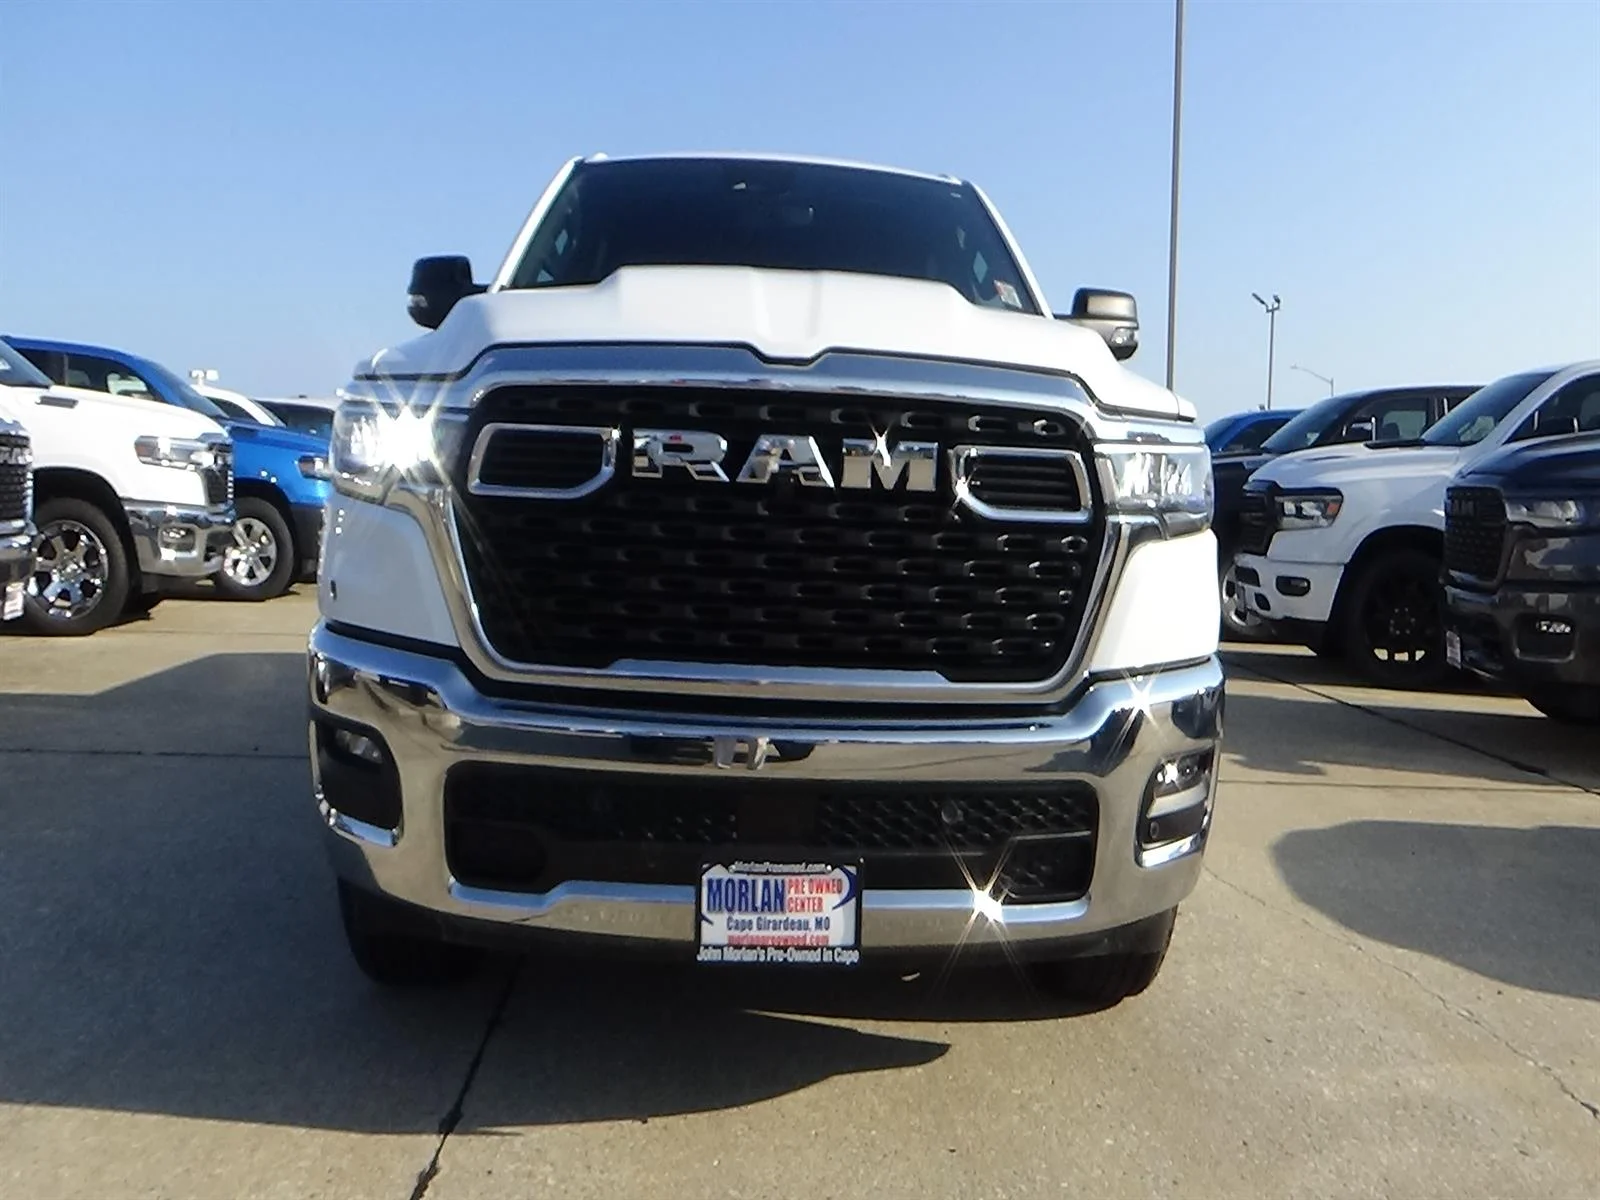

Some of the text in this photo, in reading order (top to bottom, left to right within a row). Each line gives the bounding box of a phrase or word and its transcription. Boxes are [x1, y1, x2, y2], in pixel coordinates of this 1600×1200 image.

[632, 427, 939, 492] RAM
[707, 878, 785, 912] MORLAN
[788, 879, 843, 894] PRE OWNED
[788, 897, 823, 912] CENTER
[727, 916, 753, 932] Cape
[815, 916, 830, 931] MO
[696, 946, 722, 961] John
[767, 946, 821, 962] Pre-Owned
[834, 947, 859, 965] Cape
